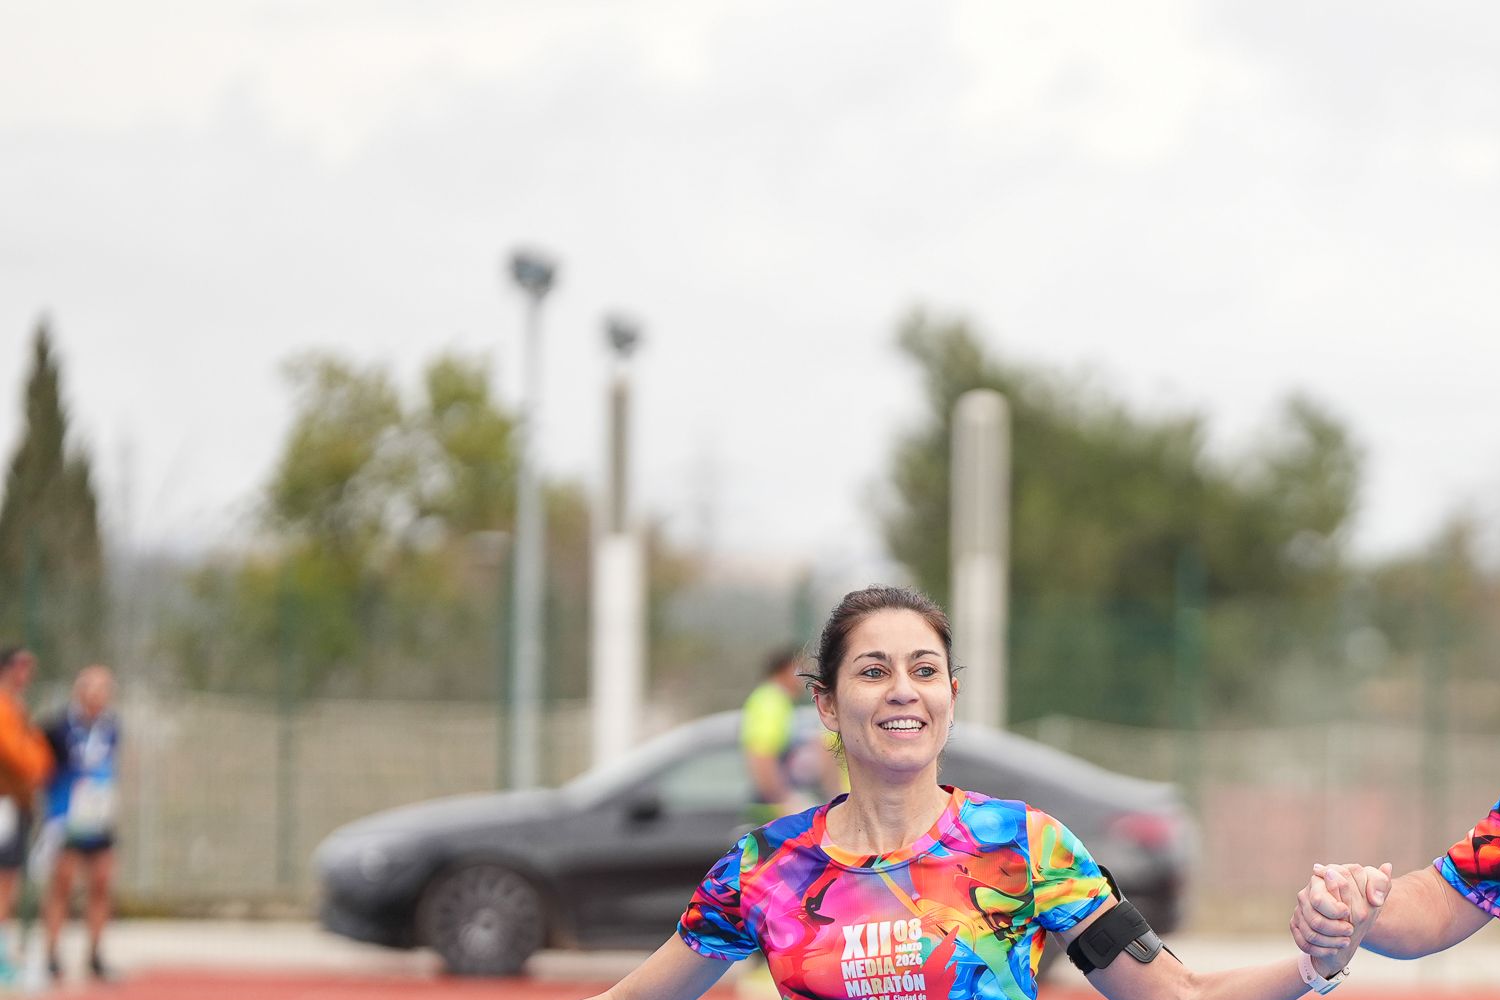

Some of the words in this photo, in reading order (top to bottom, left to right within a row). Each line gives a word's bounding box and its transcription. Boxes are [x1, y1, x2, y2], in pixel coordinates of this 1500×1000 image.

[841, 921, 891, 961] XII
[894, 918, 922, 943] 08
[894, 941, 922, 953] MARZO
[841, 957, 895, 980] MEDIA
[895, 953, 923, 968] 2026
[844, 970, 926, 998] MARATÓN
